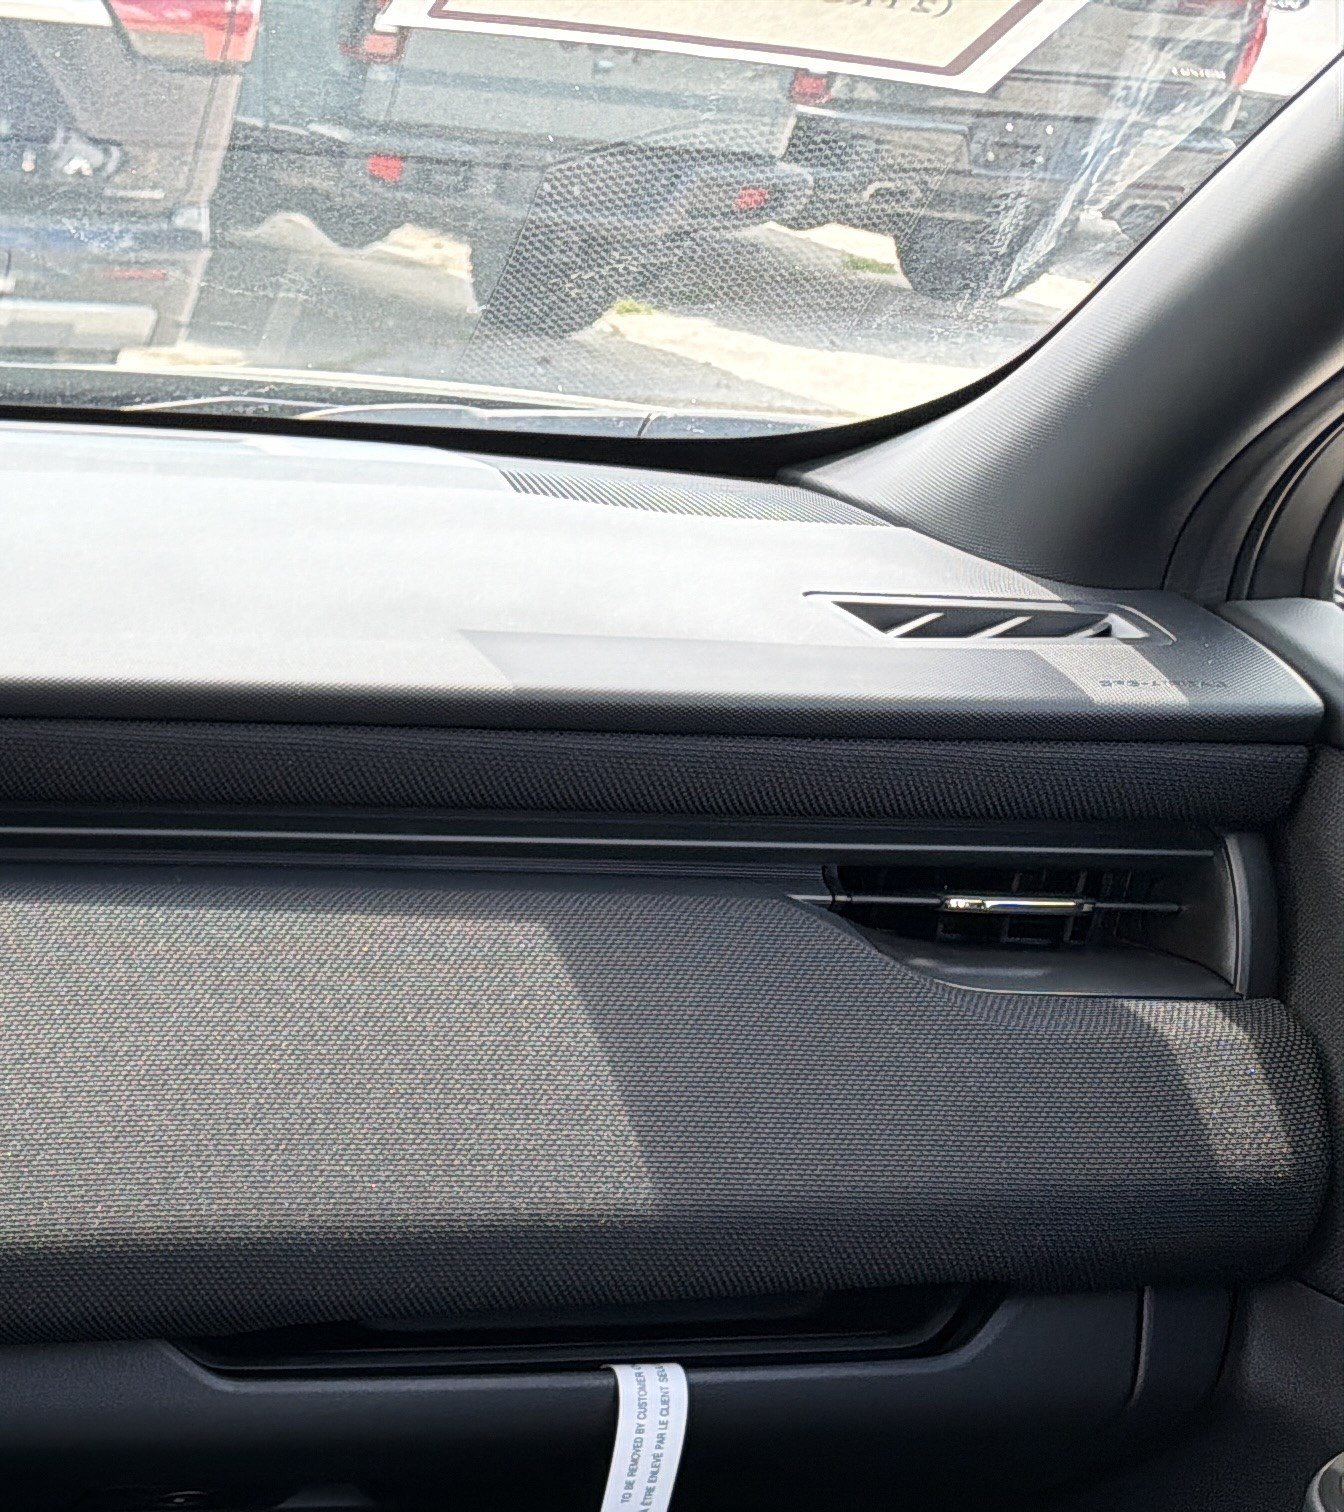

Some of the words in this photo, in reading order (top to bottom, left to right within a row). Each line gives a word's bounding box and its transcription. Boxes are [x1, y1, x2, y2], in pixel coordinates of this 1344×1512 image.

[635, 1370, 648, 1422] CUSTOMER
[635, 1422, 646, 1436] BY
[658, 1419, 669, 1431] LE
[626, 1436, 643, 1479] REMOVED
[624, 1479, 635, 1491] BE
